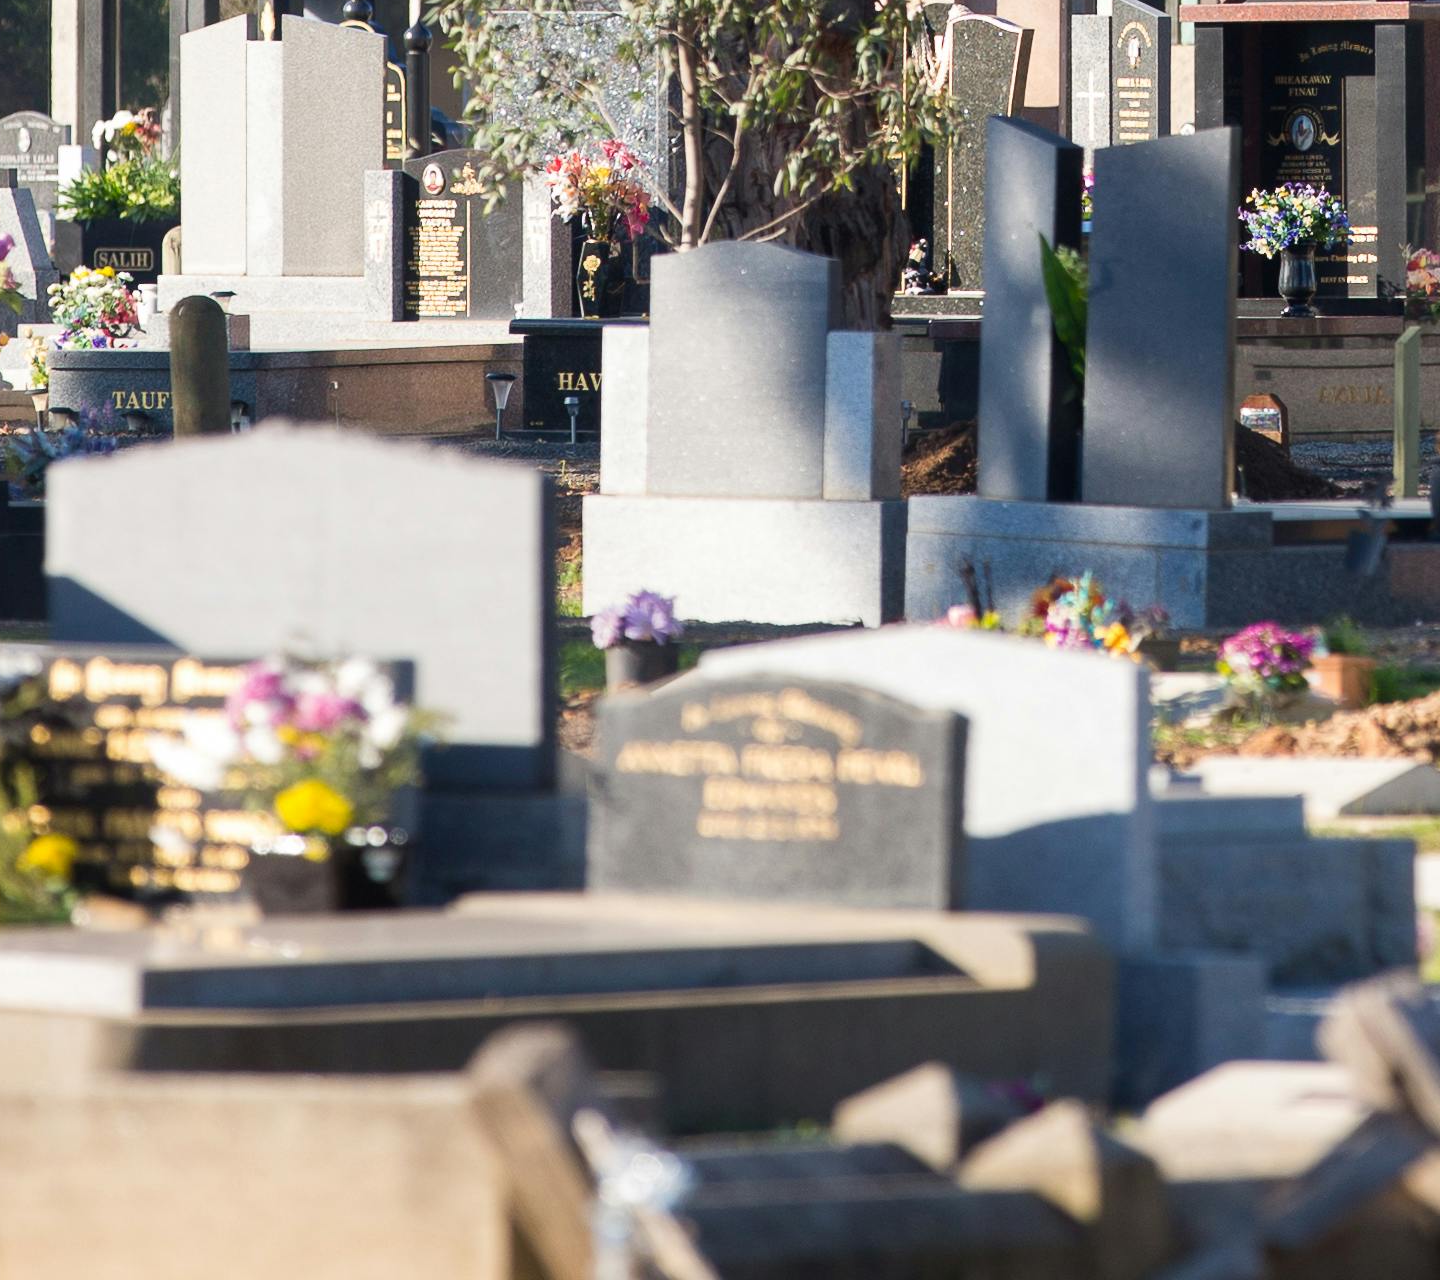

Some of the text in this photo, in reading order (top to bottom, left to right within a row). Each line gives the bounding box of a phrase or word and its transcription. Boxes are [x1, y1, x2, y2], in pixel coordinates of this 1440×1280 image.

[1274, 75, 1332, 85] BREAKAWAY
[98, 252, 149, 268] SALIH
[558, 372, 602, 392] HAV
[112, 391, 173, 410] TAUF
